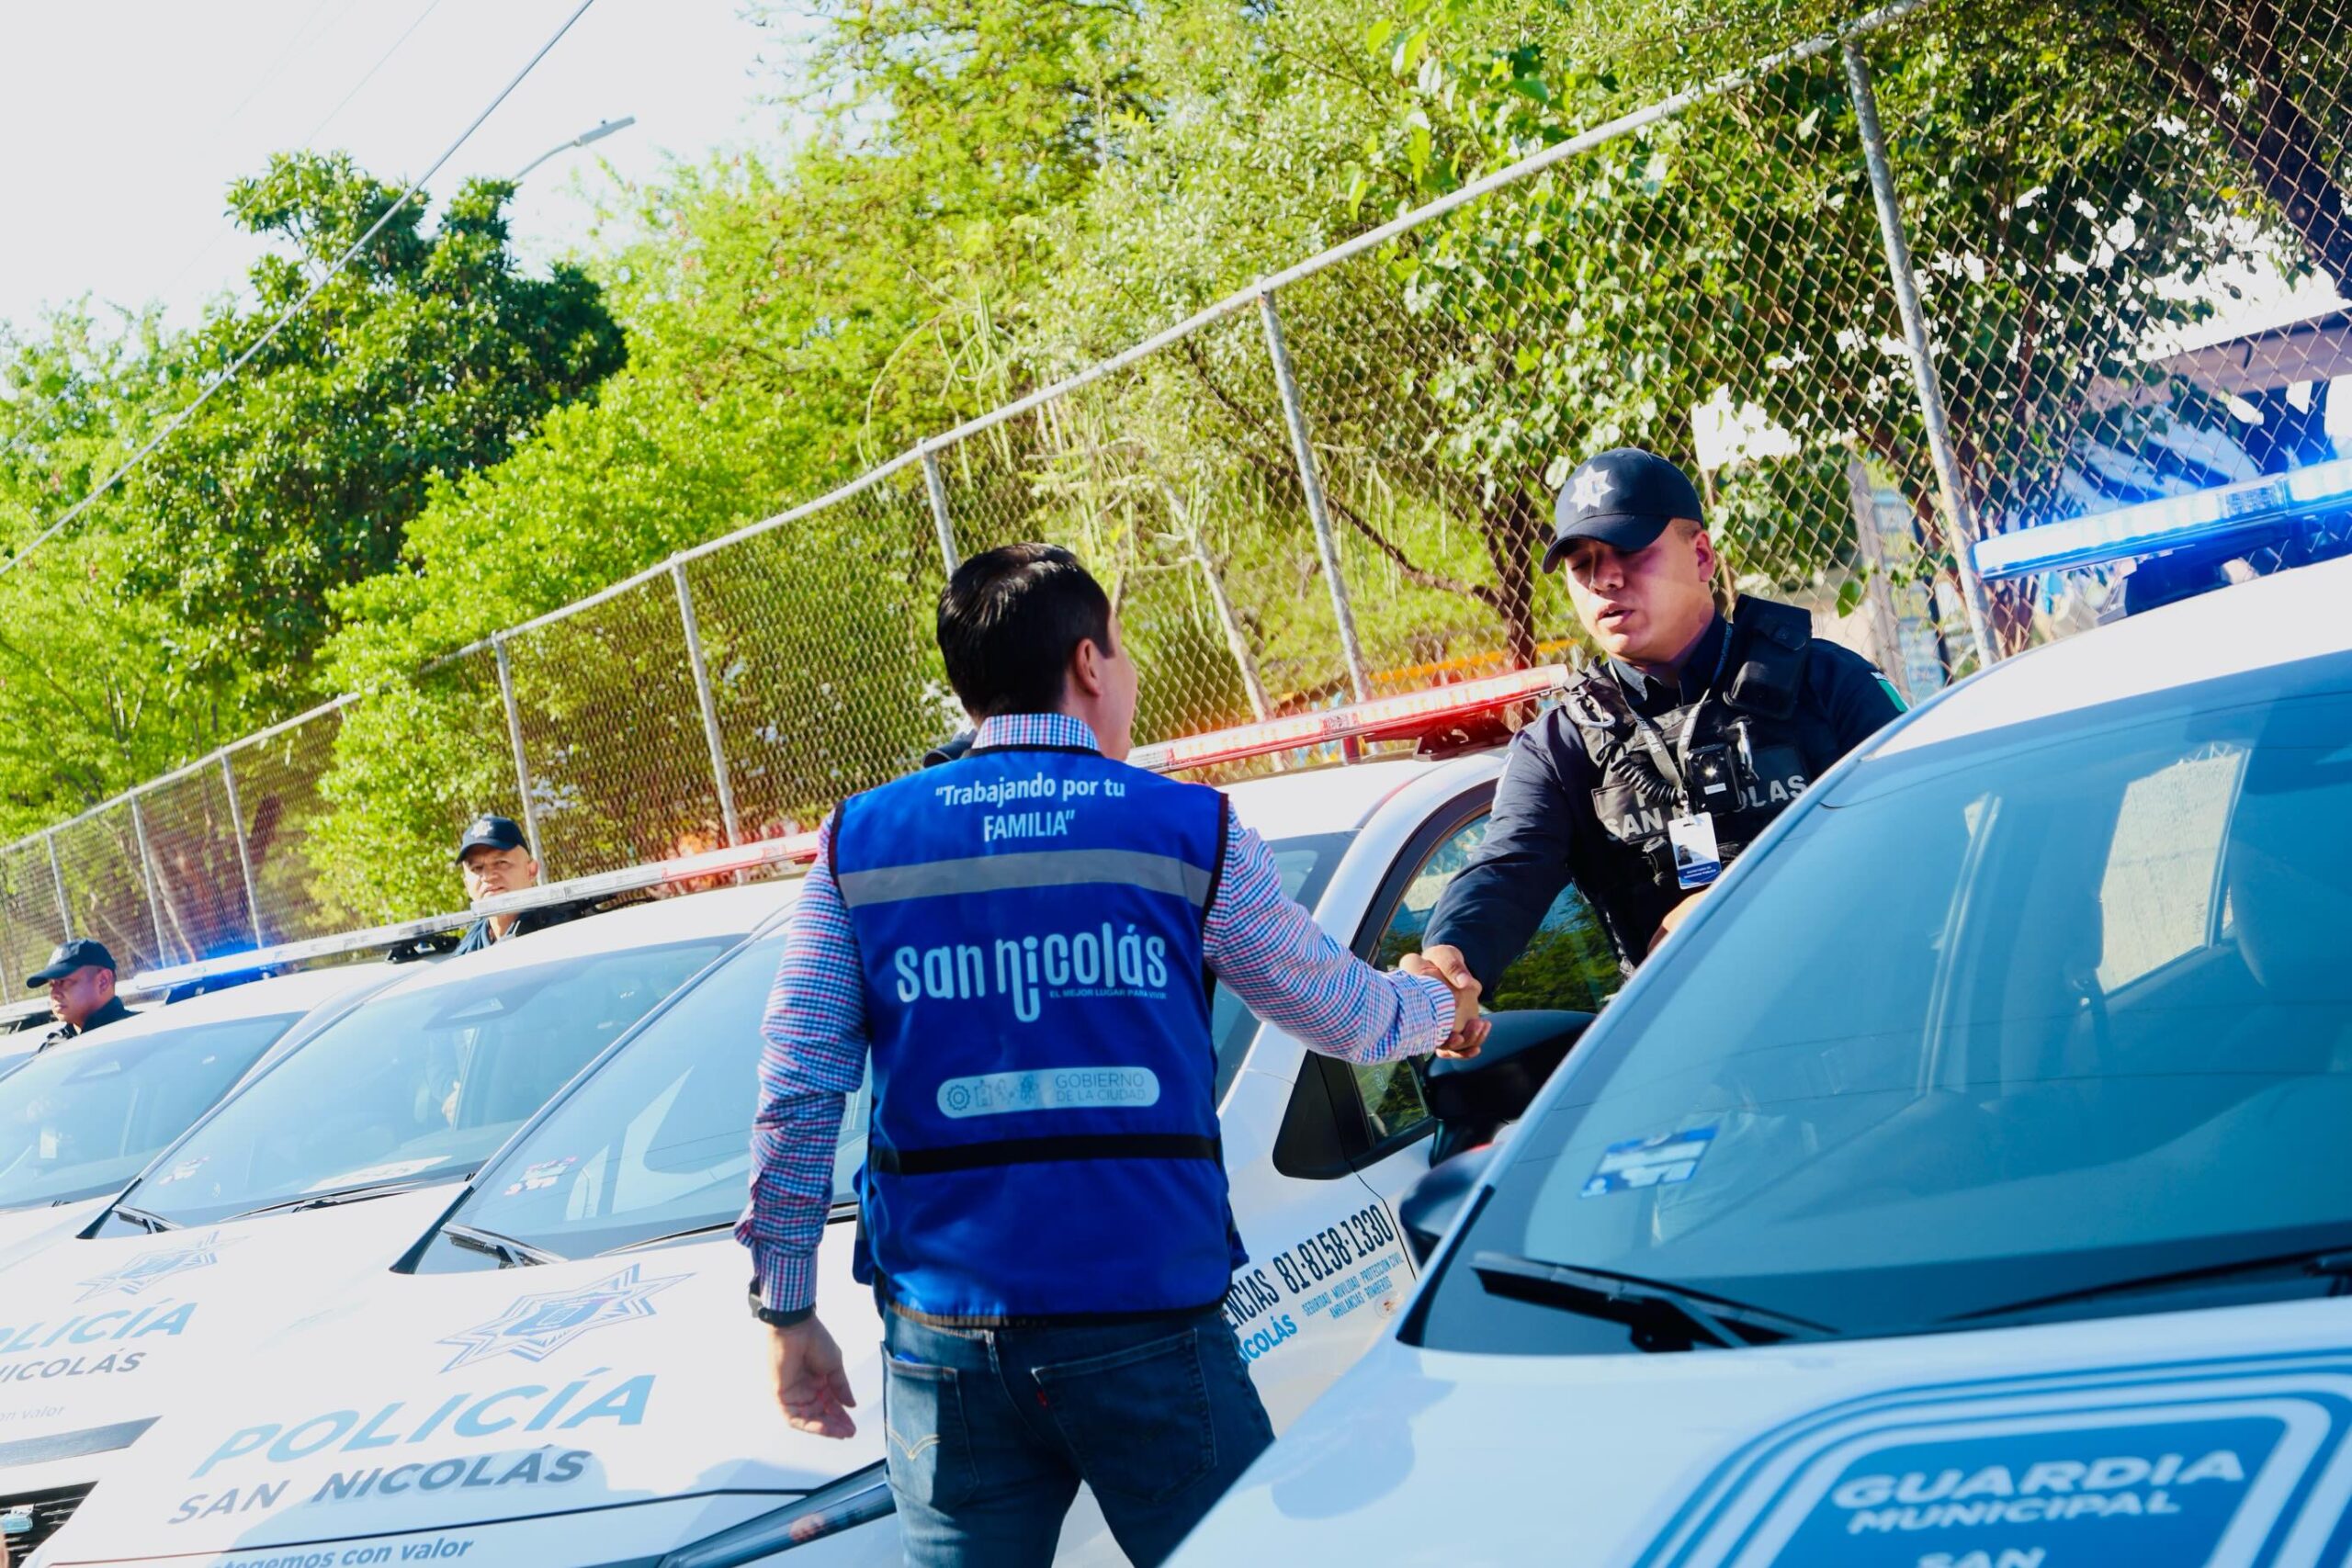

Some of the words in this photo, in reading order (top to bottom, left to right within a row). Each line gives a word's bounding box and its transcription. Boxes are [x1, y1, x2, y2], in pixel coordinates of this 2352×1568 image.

[1062, 779, 1099, 802] por
[1103, 779, 1125, 797] tu
[1603, 807, 1664, 841] SAN
[1063, 988, 1093, 998] MEJOR
[1095, 988, 1125, 998] LUGAR
[1056, 1072, 1146, 1090] GOBIERNO
[1057, 1089, 1073, 1103] DE
[1078, 1089, 1095, 1102] LA
[1102, 1087, 1148, 1102] CIUDAD
[0, 1297, 198, 1354] LICÍA
[22, 1405, 66, 1420] valor
[188, 1367, 657, 1480] POLICÍA
[166, 1479, 291, 1525] SAN
[311, 1443, 594, 1503] NICOLÁS
[1832, 1450, 2245, 1509] GUARDIA
[1847, 1490, 2181, 1535] MUNICIPAL
[341, 1546, 393, 1565] con
[401, 1538, 475, 1562] valor
